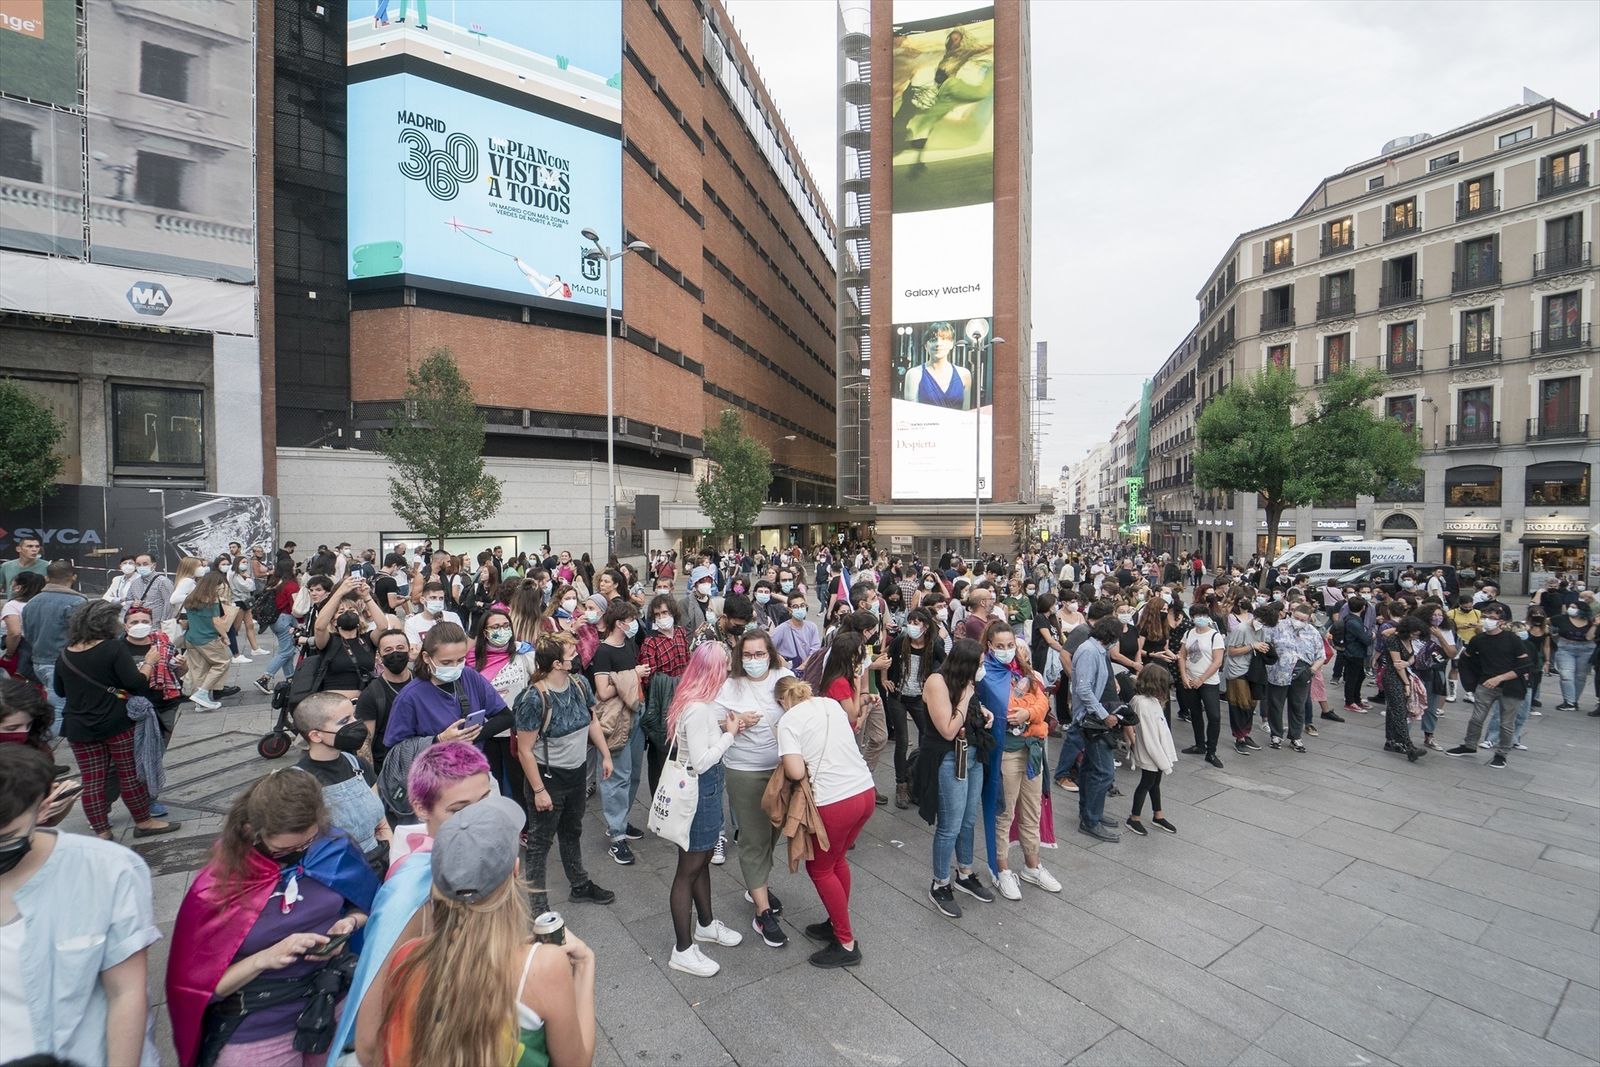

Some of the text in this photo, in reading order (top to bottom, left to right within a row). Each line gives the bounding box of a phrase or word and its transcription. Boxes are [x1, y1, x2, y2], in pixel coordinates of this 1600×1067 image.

[397, 110, 446, 133] MADRID
[398, 128, 479, 201] 360
[488, 137, 570, 172] UN PLAN CON
[488, 176, 571, 215] A TODOS
[488, 201, 498, 209] UN
[498, 204, 522, 215] MADRID
[522, 209, 537, 219] CON
[550, 216, 569, 226] ZONAS
[496, 208, 519, 219] VERDES
[527, 216, 546, 226] NORTE
[132, 286, 170, 308] MA
[904, 283, 981, 299] Galaxy Watch4
[13, 527, 102, 544] SYCA
[1446, 522, 1498, 531] RODILLA
[1526, 523, 1587, 532] RODILLA
